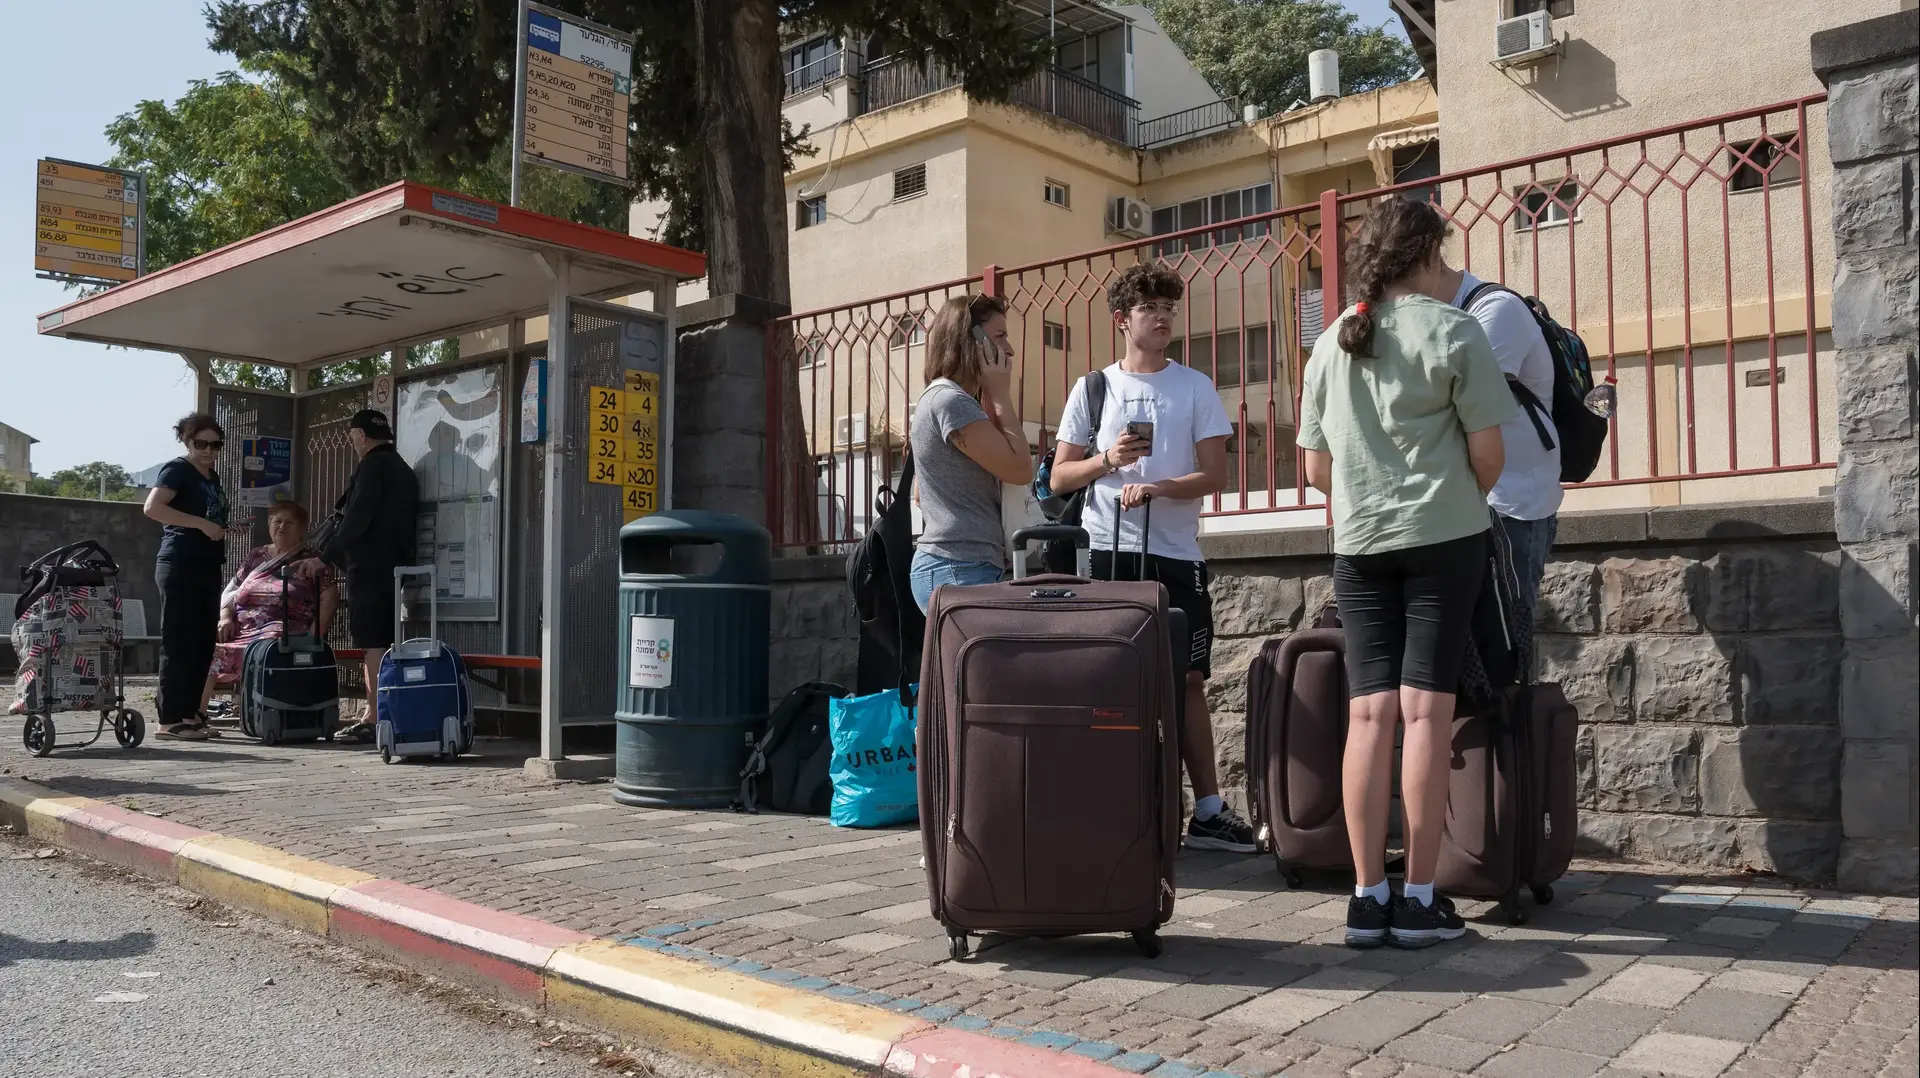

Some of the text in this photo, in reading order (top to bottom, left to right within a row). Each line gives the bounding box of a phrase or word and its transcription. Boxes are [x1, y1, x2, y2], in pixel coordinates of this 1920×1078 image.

[621, 41, 632, 54] תל
[580, 54, 605, 69] 52295
[527, 86, 550, 101] 24,36
[527, 104, 538, 115] 30
[567, 96, 612, 118] קרית שמונה
[526, 122, 536, 132] 32
[572, 115, 612, 134] כפר סאלד
[525, 139, 536, 150] 34
[39, 178, 53, 187] 451
[40, 204, 62, 215] 89,93
[39, 231, 67, 242] 86,88
[38, 245, 48, 253] 37
[75, 250, 96, 261] בלבד
[599, 391, 617, 410] 24
[642, 397, 652, 414] 4
[599, 414, 619, 433] 30
[598, 439, 617, 458] 32
[637, 441, 654, 460] 35
[596, 462, 615, 481] 34
[627, 490, 653, 509] 451
[63, 693, 81, 701] JUST
